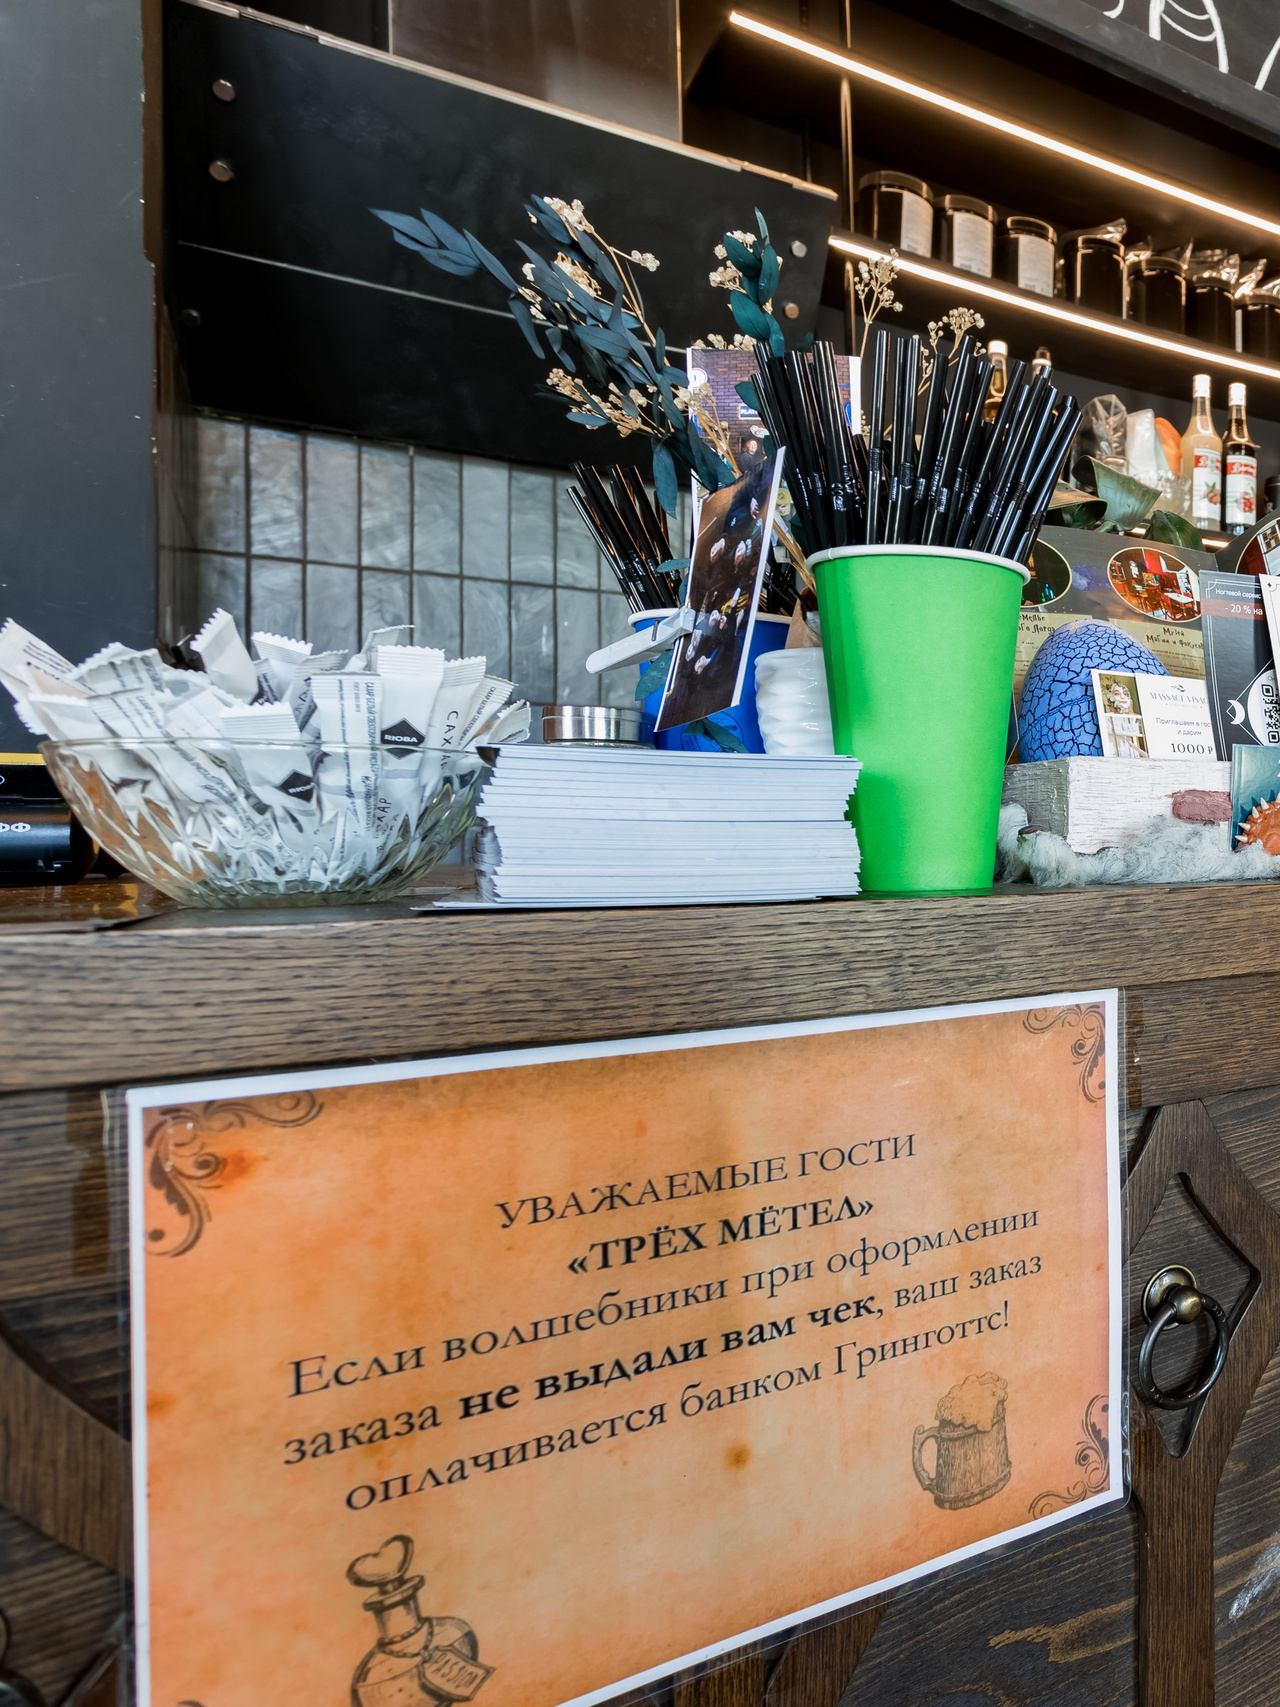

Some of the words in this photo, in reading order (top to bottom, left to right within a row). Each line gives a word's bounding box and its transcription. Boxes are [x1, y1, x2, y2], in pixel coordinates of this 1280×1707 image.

[1215, 588, 1241, 598] Ногтевой
[1242, 591, 1262, 600] сервис
[1230, 603, 1242, 613] 20
[384, 734, 418, 744] RIOBA
[1156, 717, 1195, 728] Приглашаем
[1171, 743, 1205, 755] 1000
[495, 1156, 789, 1229] УВАЖАЕМЫЕ
[797, 1133, 917, 1178] ГОСТИ
[566, 1222, 708, 1276] «ТРЁХ
[717, 1196, 874, 1248] МЁТЕЛ»
[286, 1346, 427, 1398] Если
[441, 1278, 728, 1364] волшебники
[740, 1259, 815, 1300] при
[827, 1210, 1040, 1277] оформлении
[283, 1404, 442, 1466] заказа
[458, 1383, 521, 1420] не
[535, 1338, 708, 1400] выдали
[719, 1316, 796, 1354] вам
[807, 1294, 884, 1330] чек,
[893, 1275, 960, 1310] ваш
[968, 1255, 1043, 1290] заказ
[344, 1402, 668, 1512] оплачивается
[680, 1362, 821, 1418] банком
[832, 1300, 1010, 1380] Гринготтс!
